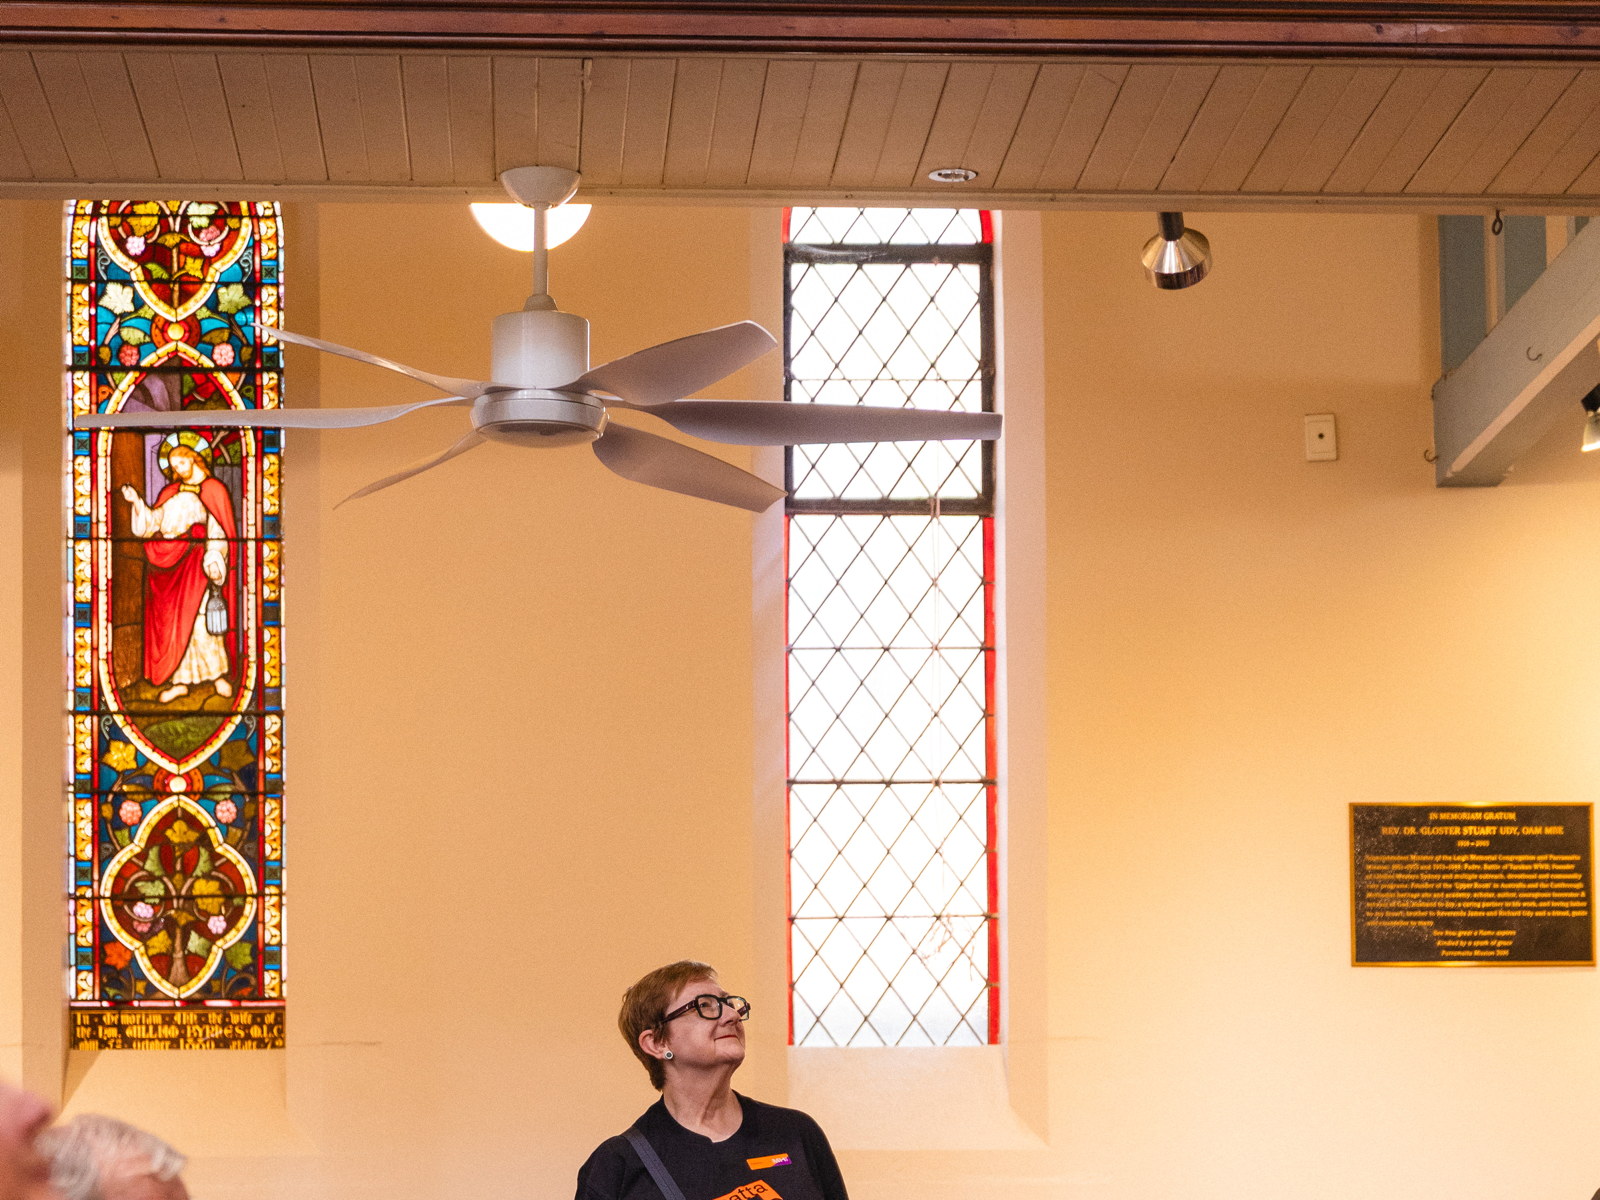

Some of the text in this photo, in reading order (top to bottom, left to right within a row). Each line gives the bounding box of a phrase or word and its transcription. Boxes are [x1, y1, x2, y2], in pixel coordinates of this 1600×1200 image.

[1440, 812, 1482, 820] MEMORIAM
[1420, 826, 1460, 835] GLOSTER
[1463, 826, 1498, 835] STUART
[186, 1024, 246, 1038] BYRNES
